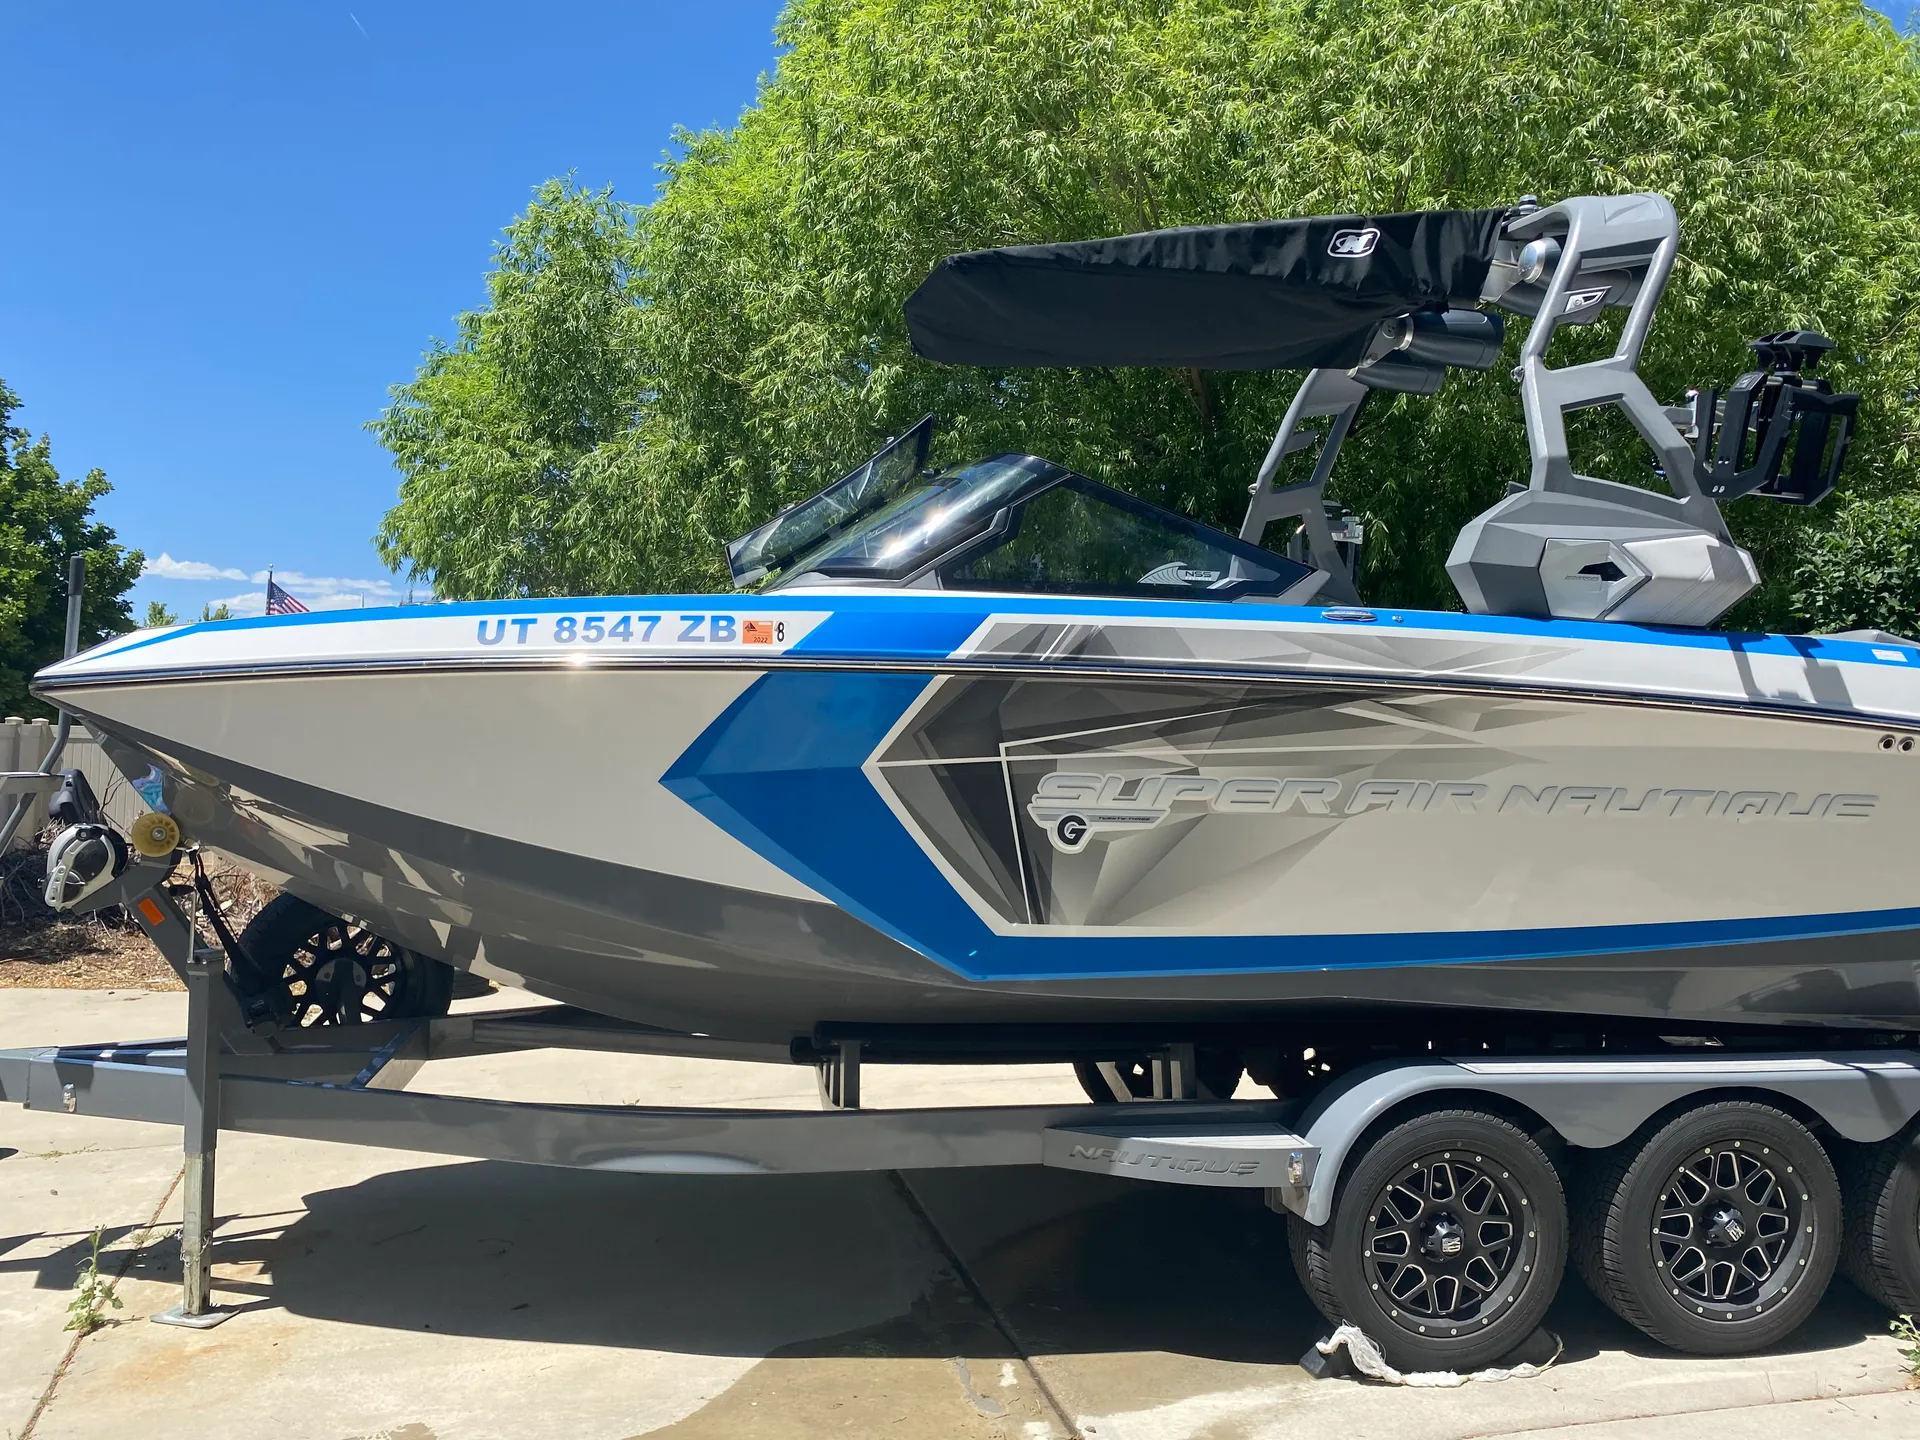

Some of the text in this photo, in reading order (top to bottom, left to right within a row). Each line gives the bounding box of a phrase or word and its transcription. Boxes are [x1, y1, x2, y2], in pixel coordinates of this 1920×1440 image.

[1184, 570, 1212, 578] NSS
[477, 615, 736, 645] UT 8547 ZB
[776, 621, 785, 643] 8
[1033, 772, 1880, 822] SUPER AIR NAUTIQUE
[1057, 815, 1088, 846] G
[1069, 1144, 1260, 1176] NAUTIQUE
